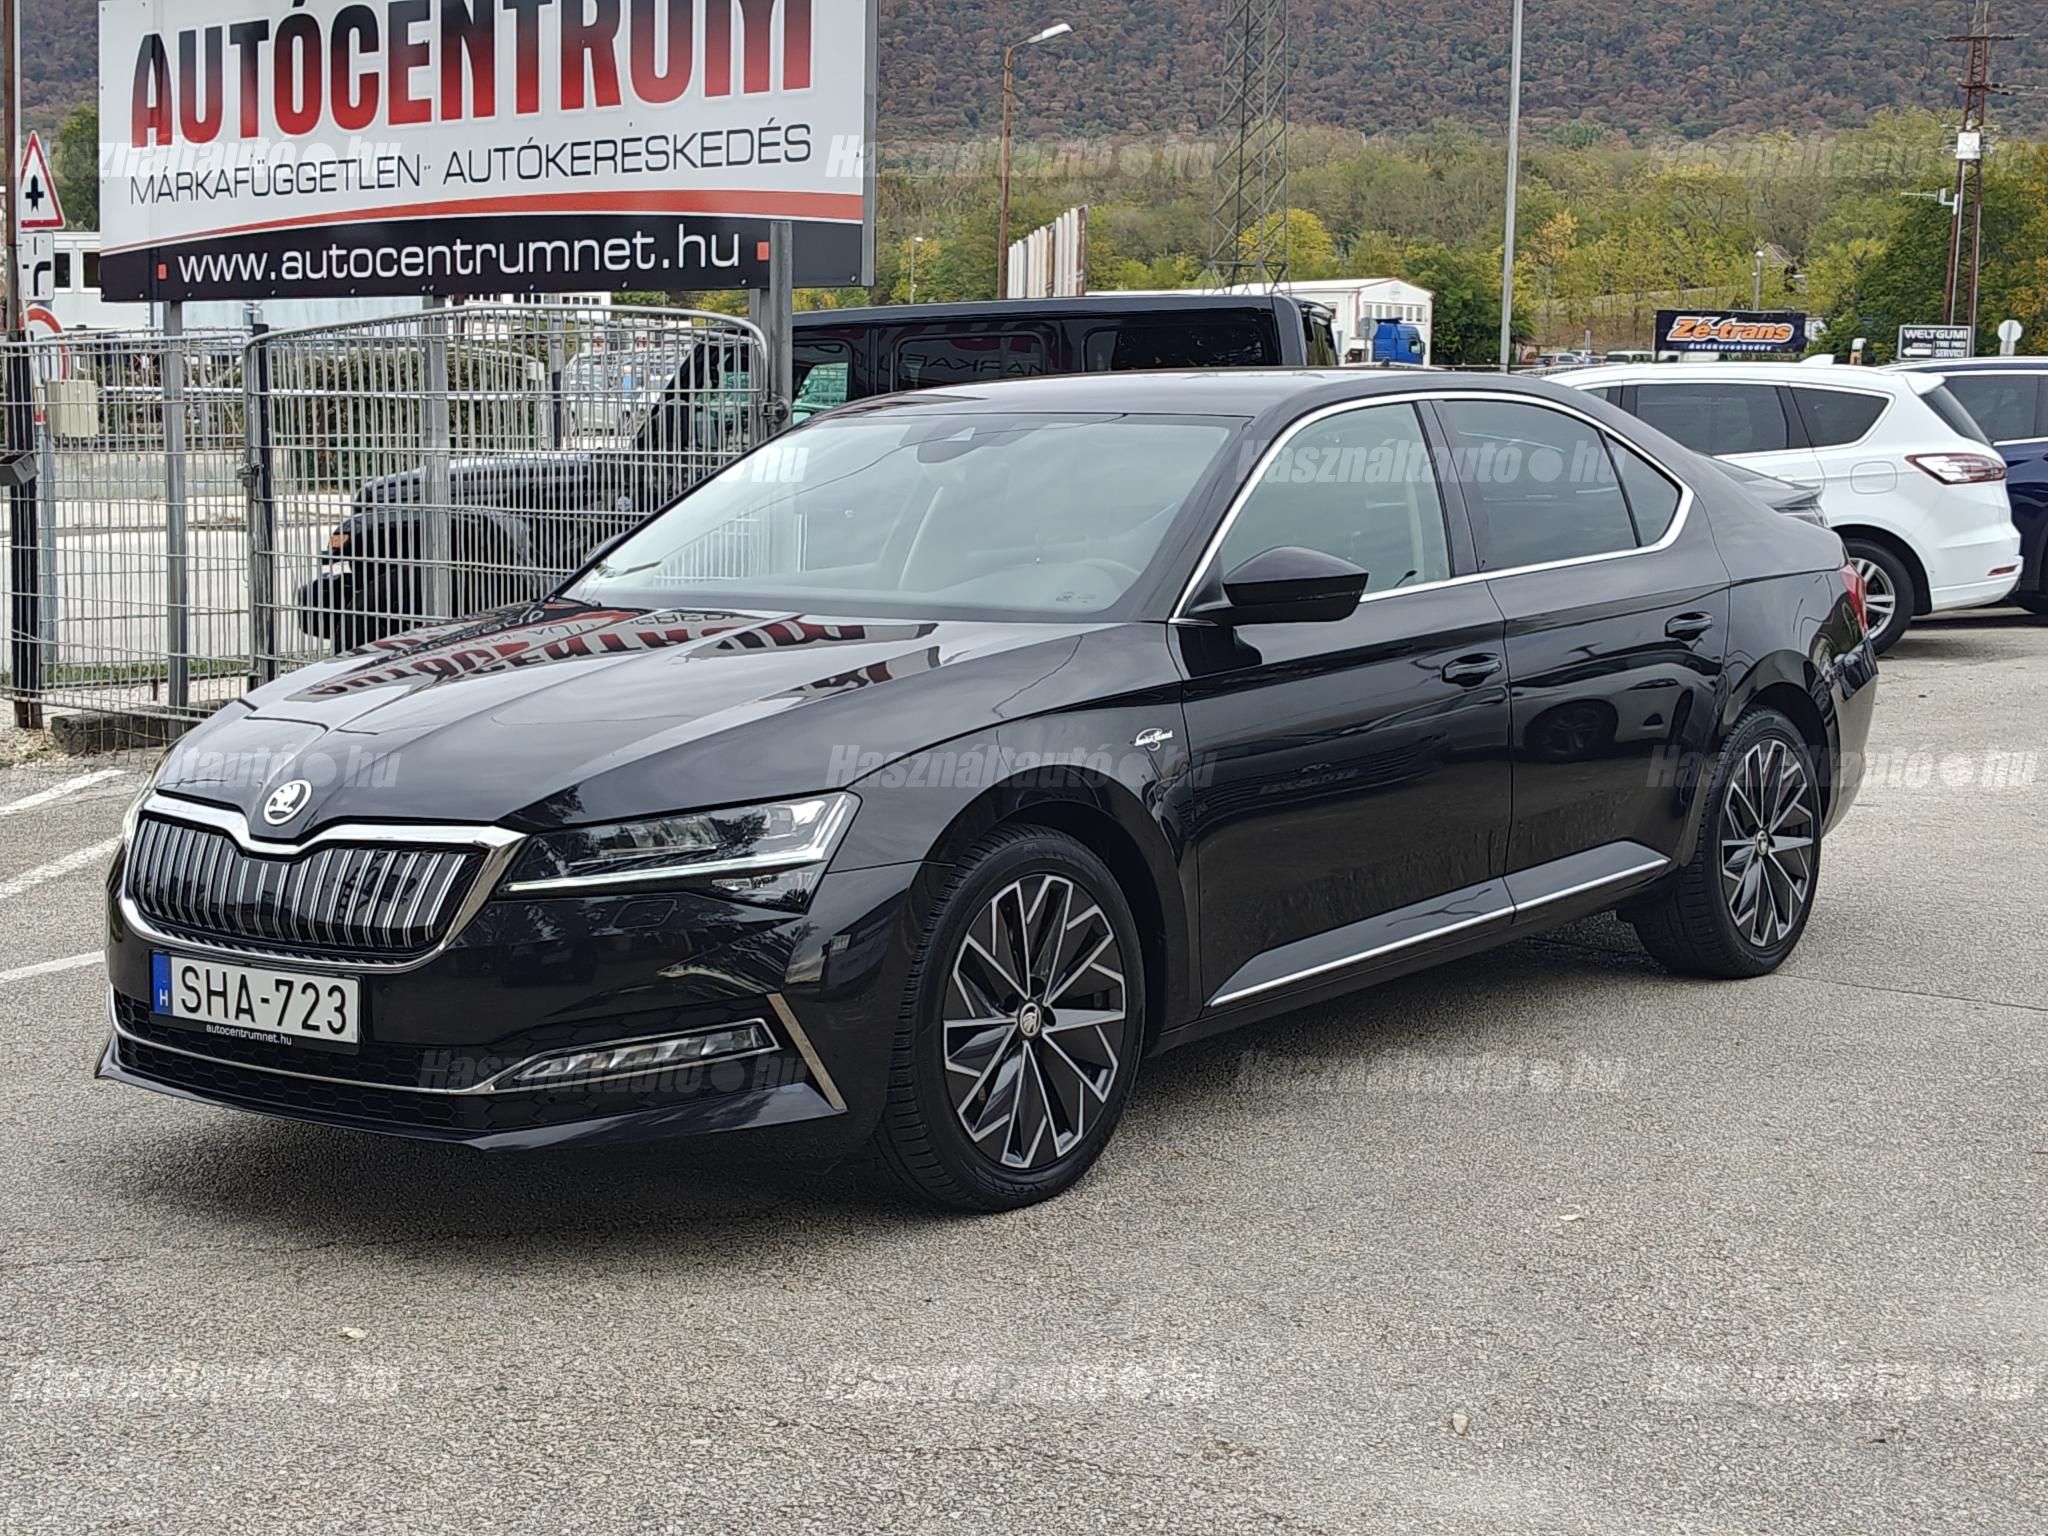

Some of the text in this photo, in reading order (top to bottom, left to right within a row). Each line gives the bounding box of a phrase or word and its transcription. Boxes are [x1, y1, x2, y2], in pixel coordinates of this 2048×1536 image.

[130, 117, 812, 206] MÁRKAFÜGGETLEN AUTÓKERESKEDÉS
[177, 223, 740, 284] www.autocentrumnet.hu
[159, 988, 170, 1007] H
[180, 965, 347, 1035] SHA-723
[205, 1023, 292, 1046] autocentrumnet.hu
